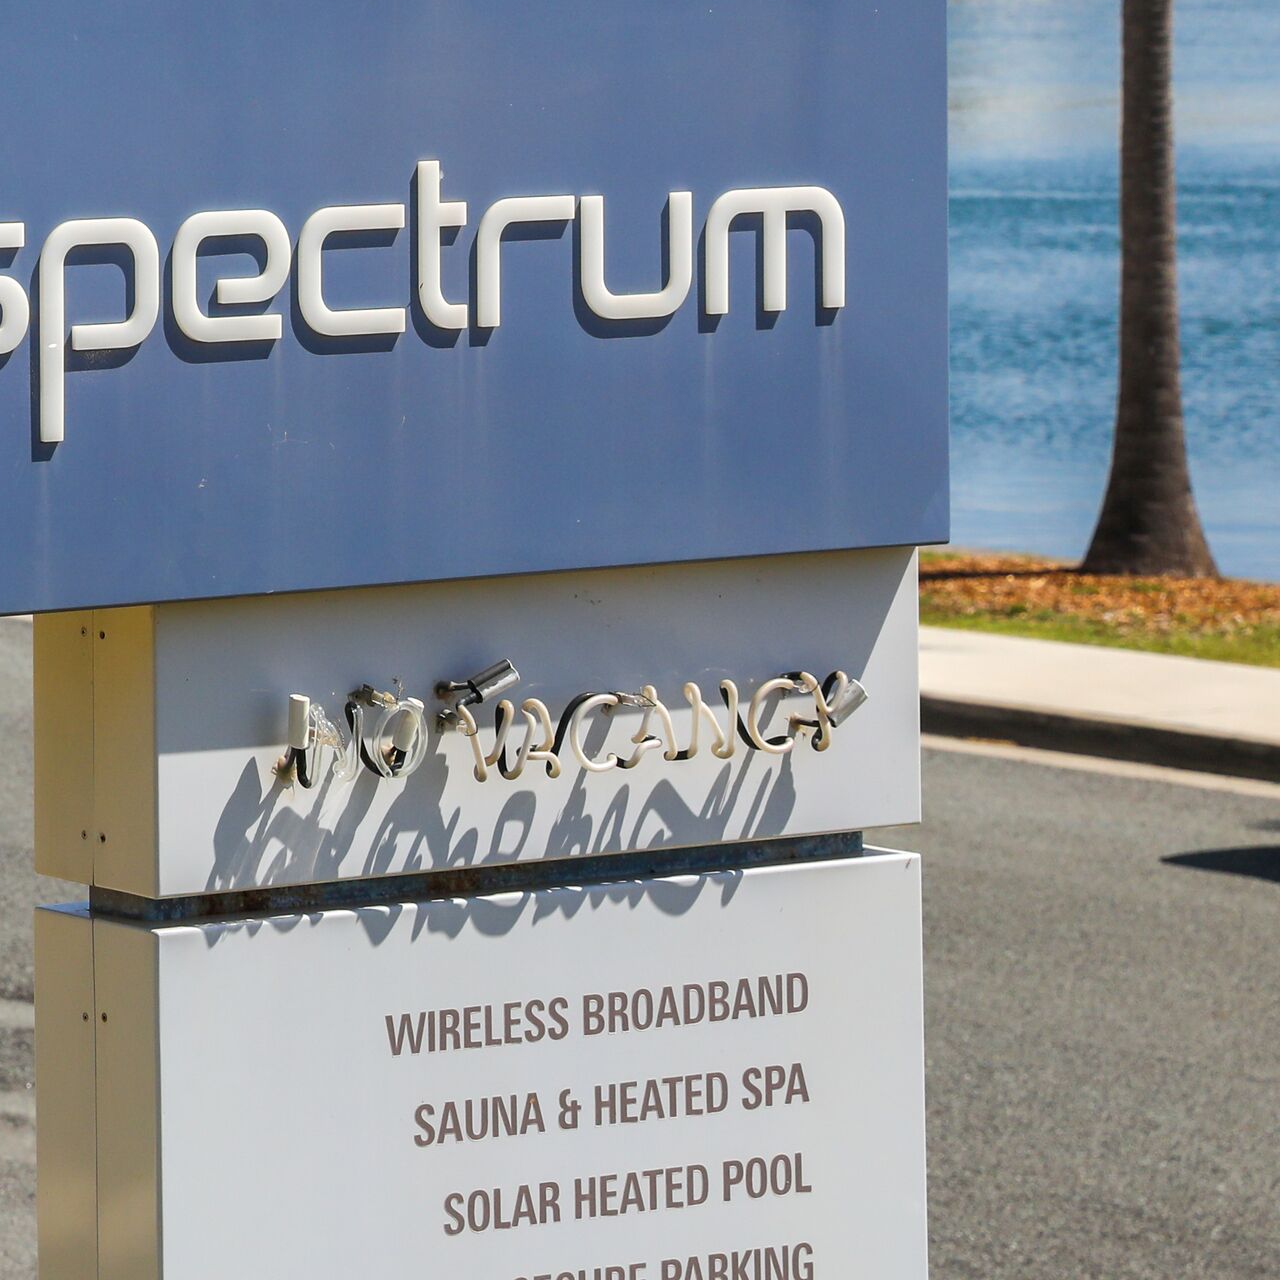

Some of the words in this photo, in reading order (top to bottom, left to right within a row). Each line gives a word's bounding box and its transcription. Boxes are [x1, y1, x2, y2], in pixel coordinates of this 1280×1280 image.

[455, 669, 850, 783] VACANCY
[384, 996, 570, 1057] WIRELESS
[582, 971, 810, 1036] BROADBAND
[413, 1091, 547, 1147] SAUNA
[557, 1087, 583, 1130] &
[593, 1071, 730, 1127] HEATED
[740, 1062, 811, 1111] SPA
[442, 1181, 561, 1236] SOLAR
[573, 1163, 710, 1220] HEATED
[721, 1152, 813, 1202] POOL
